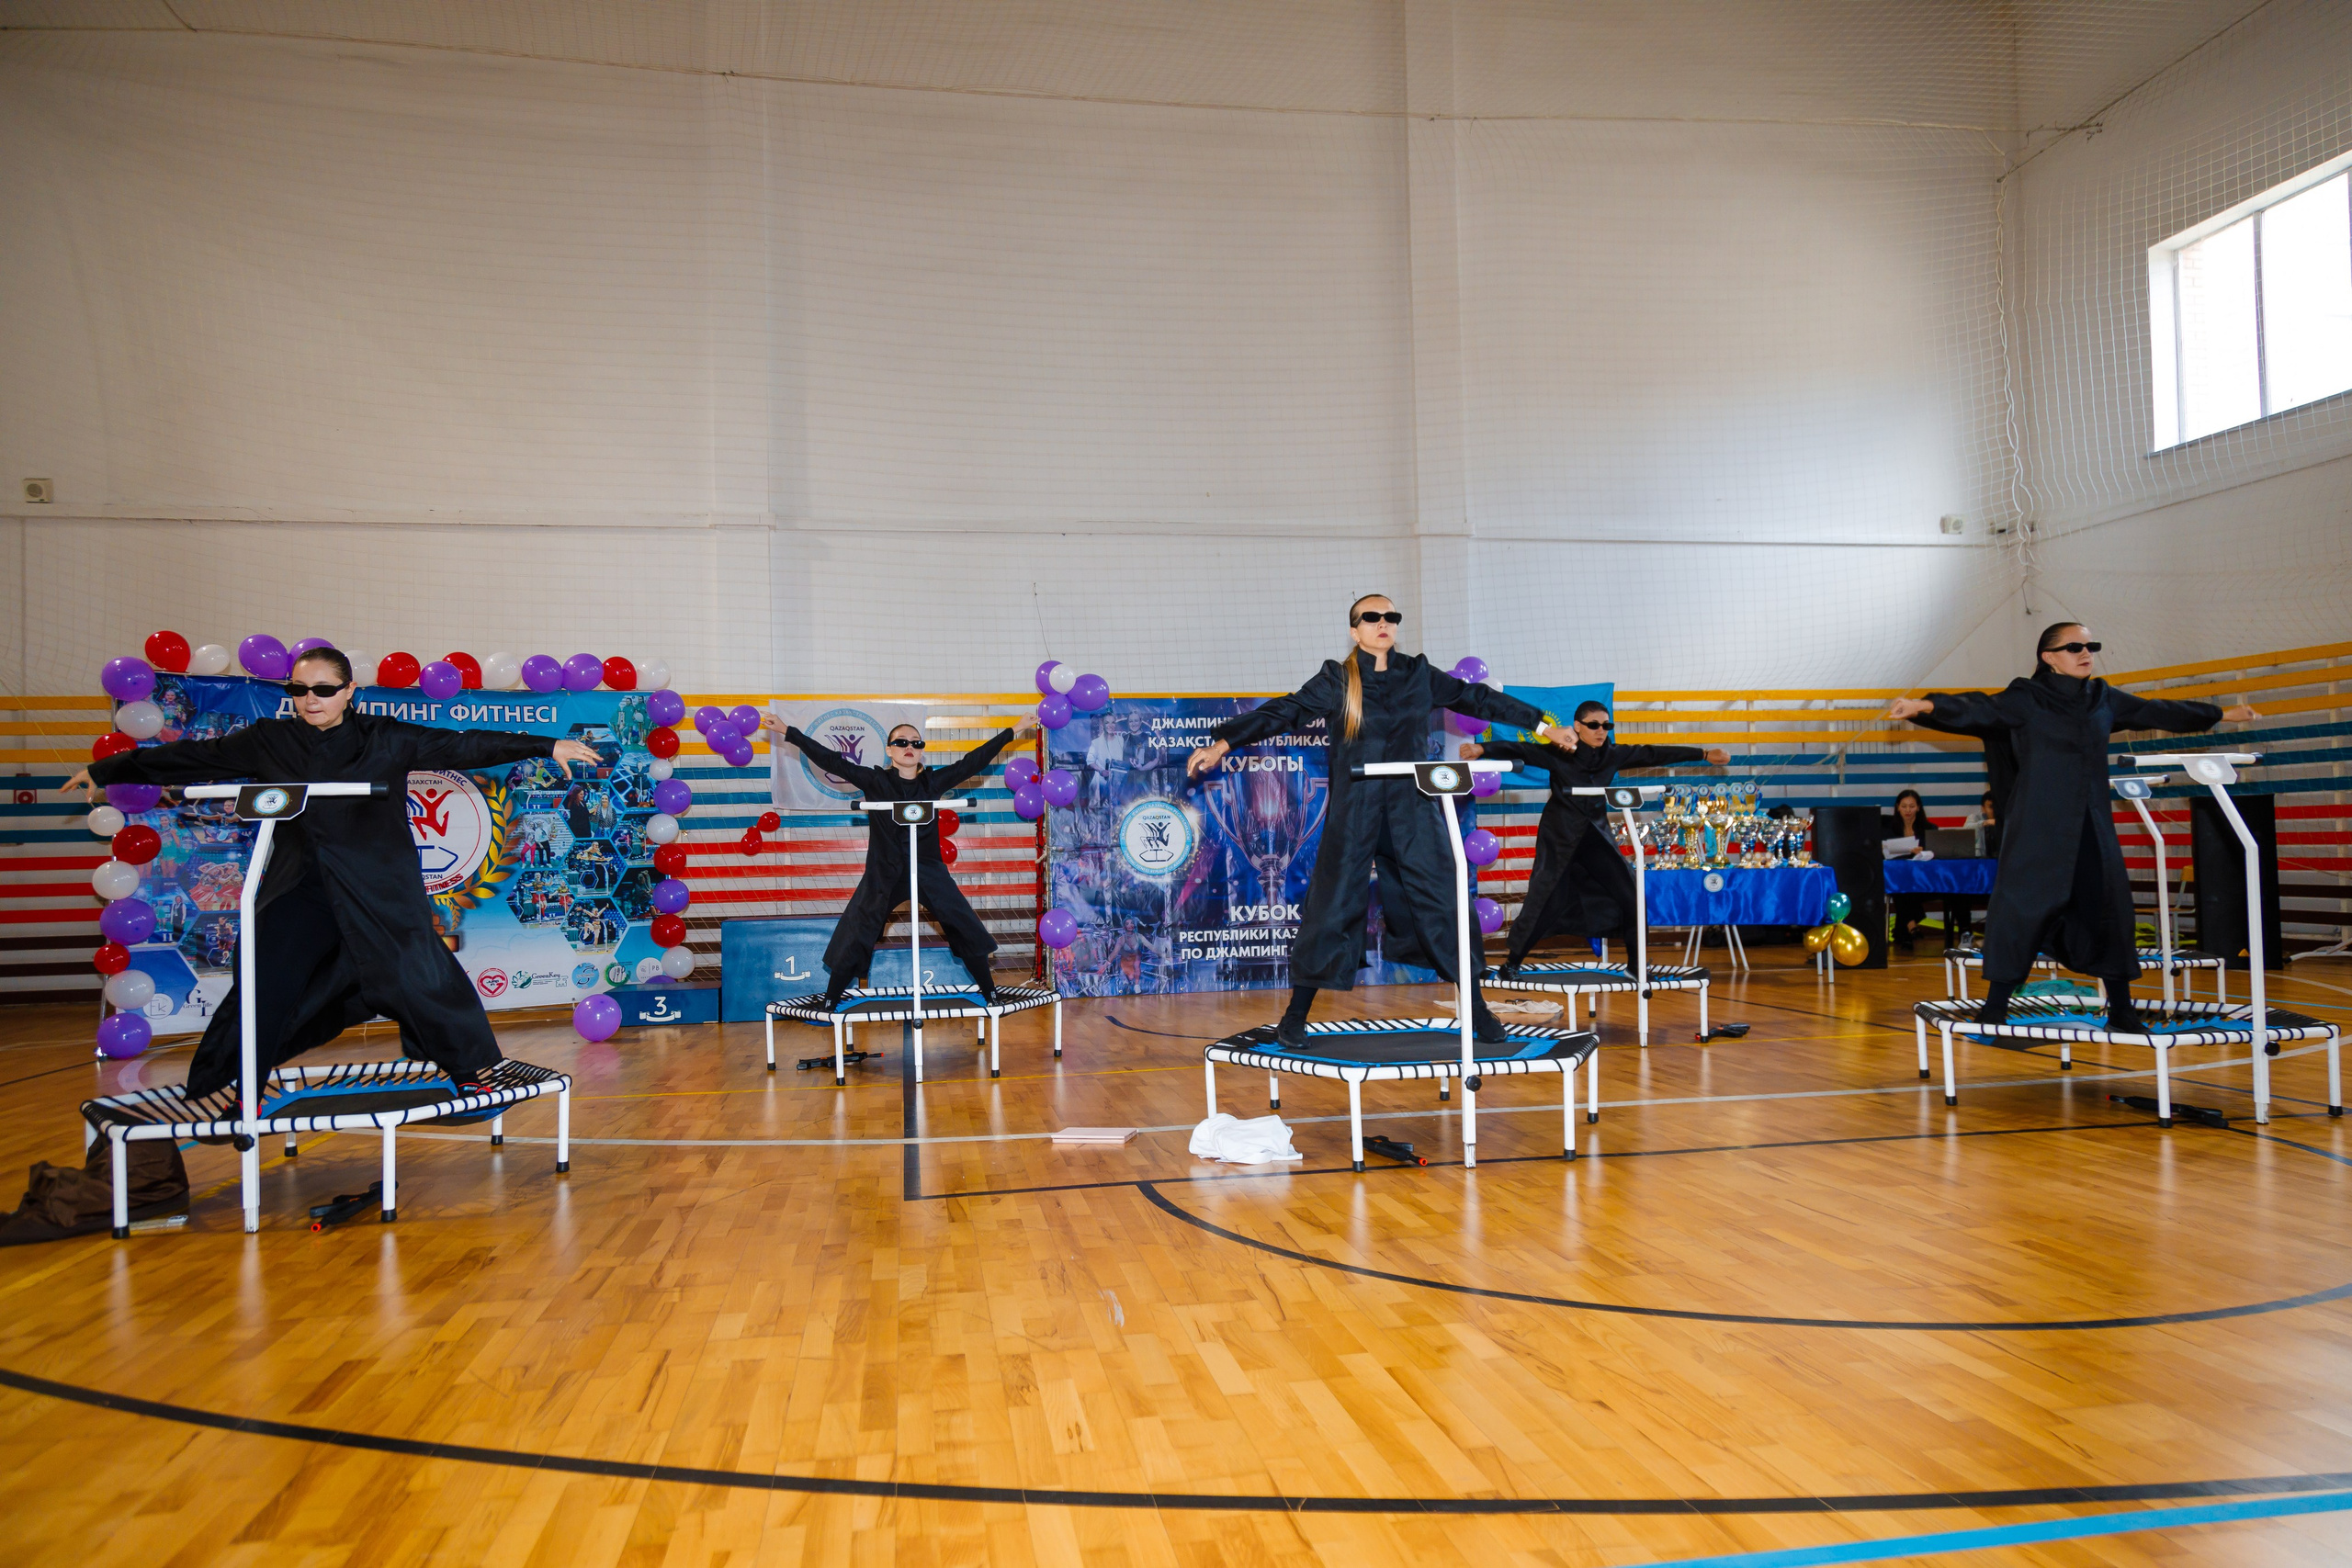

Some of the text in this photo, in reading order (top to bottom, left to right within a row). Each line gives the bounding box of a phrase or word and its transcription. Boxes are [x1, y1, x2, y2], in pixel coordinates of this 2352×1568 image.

[449, 704, 557, 723] ФИТНЕСІ
[1148, 736, 1216, 750] ҚАЗАҚСТ
[1221, 756, 1304, 773] КУБОГЫ
[1231, 904, 1301, 922] КУБОК
[1179, 928, 1299, 943] РЕСПУБЛИКИ КАЗ
[1182, 945, 1288, 961] ПО ДЖАМПИНГ
[785, 955, 795, 975] 1
[922, 970, 935, 986] 2
[654, 996, 667, 1015] 3
